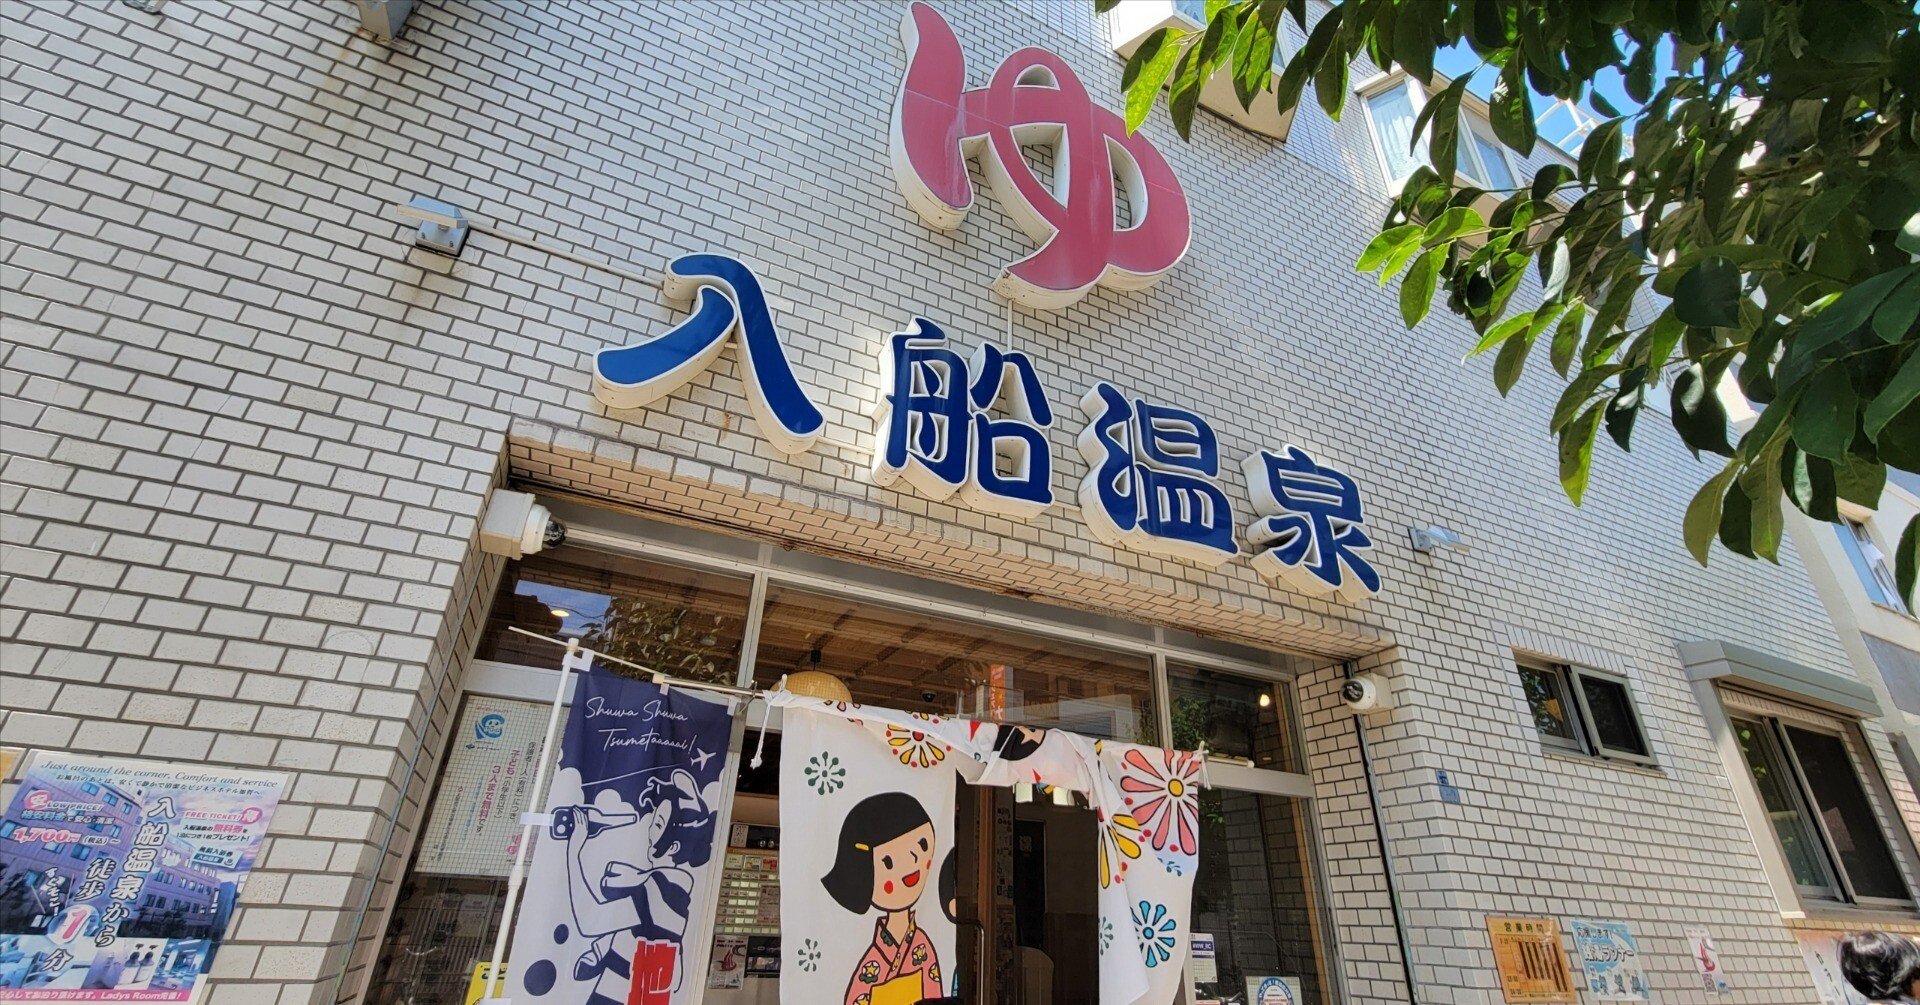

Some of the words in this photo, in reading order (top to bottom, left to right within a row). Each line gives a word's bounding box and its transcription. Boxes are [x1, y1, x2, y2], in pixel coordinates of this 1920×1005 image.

[895, 1, 1192, 295] ゆ
[594, 253, 1381, 597] 入船温泉
[585, 696, 639, 719] Shuwa
[642, 699, 688, 722] Shuwa
[41, 760, 67, 771] Just
[70, 764, 113, 774] around
[114, 766, 132, 776] the
[175, 771, 219, 784] Comfort
[220, 775, 241, 785] and
[242, 779, 278, 788] service
[47, 801, 68, 810] LOW
[185, 811, 208, 819] FREE
